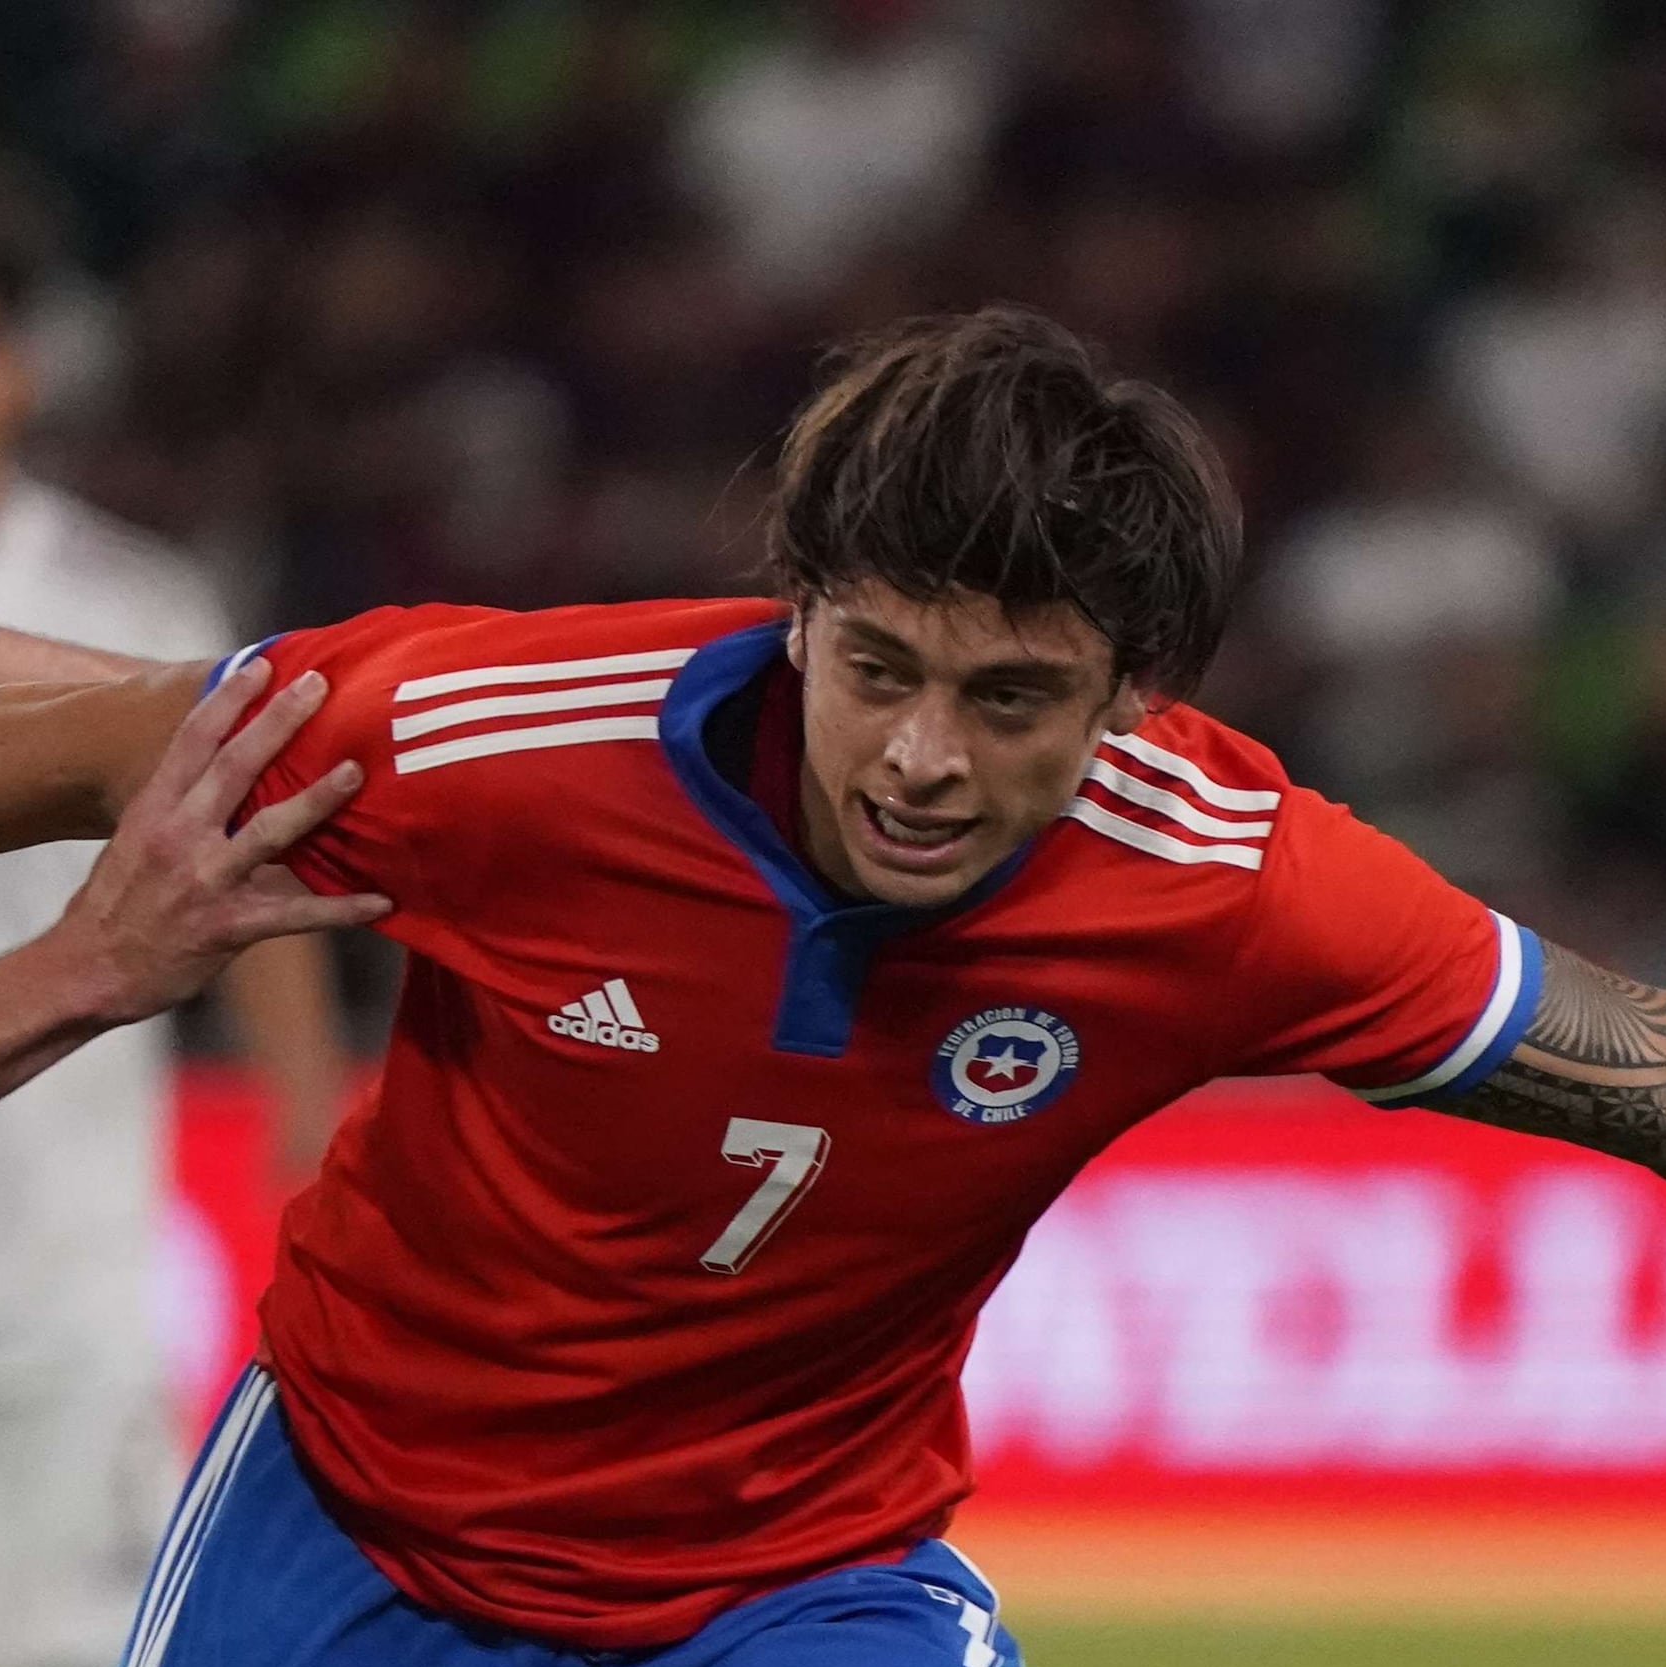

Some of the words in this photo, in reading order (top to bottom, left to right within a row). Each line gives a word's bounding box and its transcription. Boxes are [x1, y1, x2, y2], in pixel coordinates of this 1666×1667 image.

[547, 1014, 660, 1053] adidas
[952, 1098, 976, 1118] DE
[981, 1103, 1029, 1123] CHILE
[699, 1116, 831, 1275] 7
